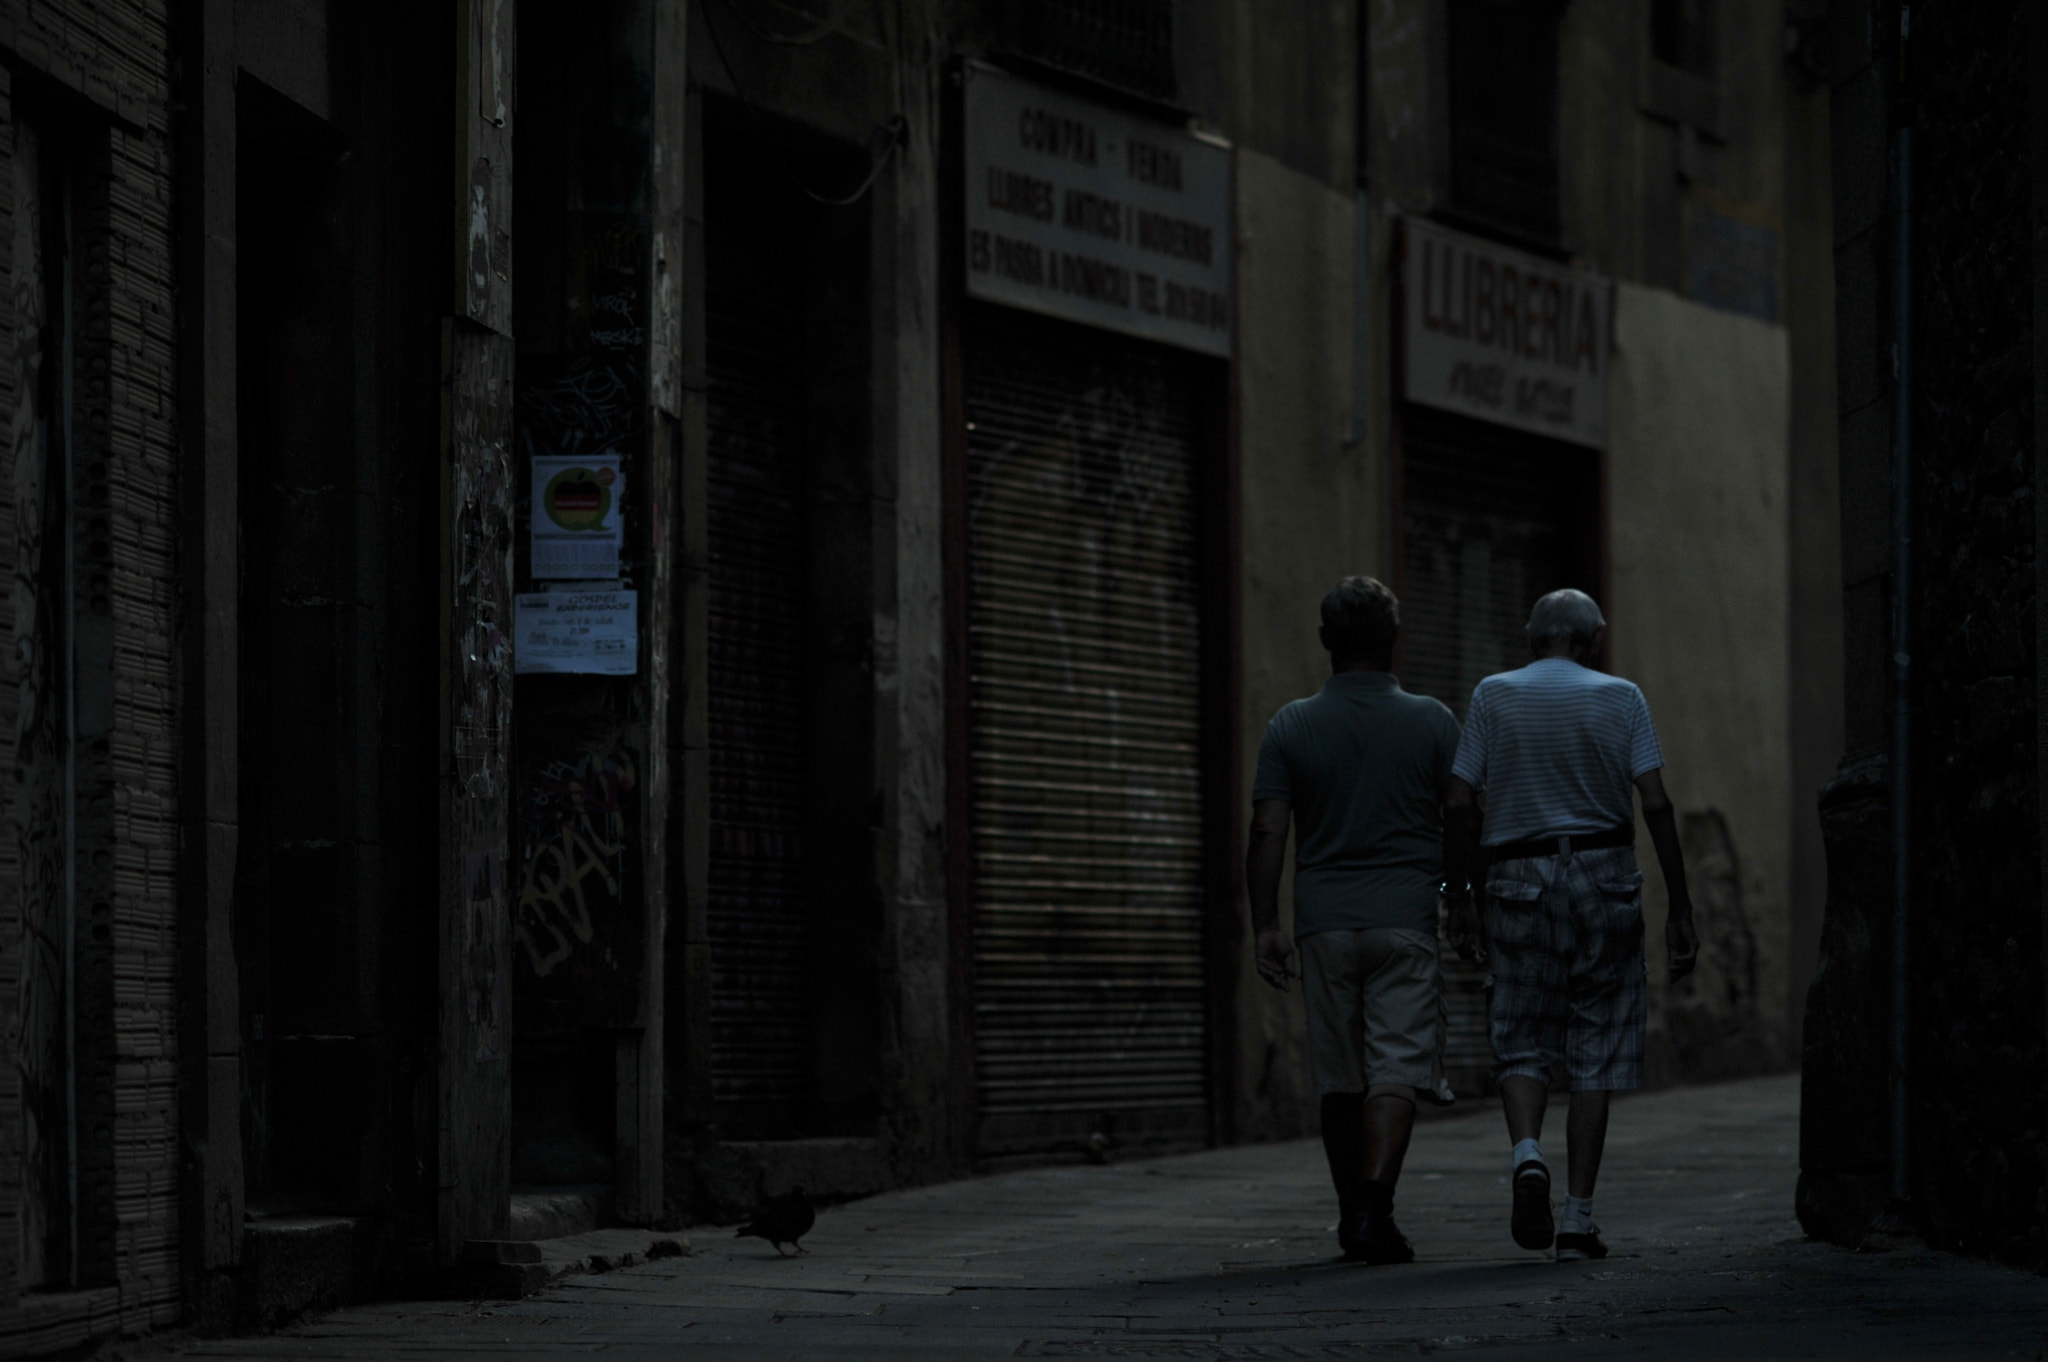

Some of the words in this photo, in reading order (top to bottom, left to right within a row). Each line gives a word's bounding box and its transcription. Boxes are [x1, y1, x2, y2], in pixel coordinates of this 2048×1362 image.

[1018, 106, 1098, 168] COMPRA
[988, 166, 1055, 225] LLIBRES
[1063, 188, 1121, 242] ANTICS
[1048, 250, 1060, 290] A
[1423, 239, 1599, 378] LLIBRERIA
